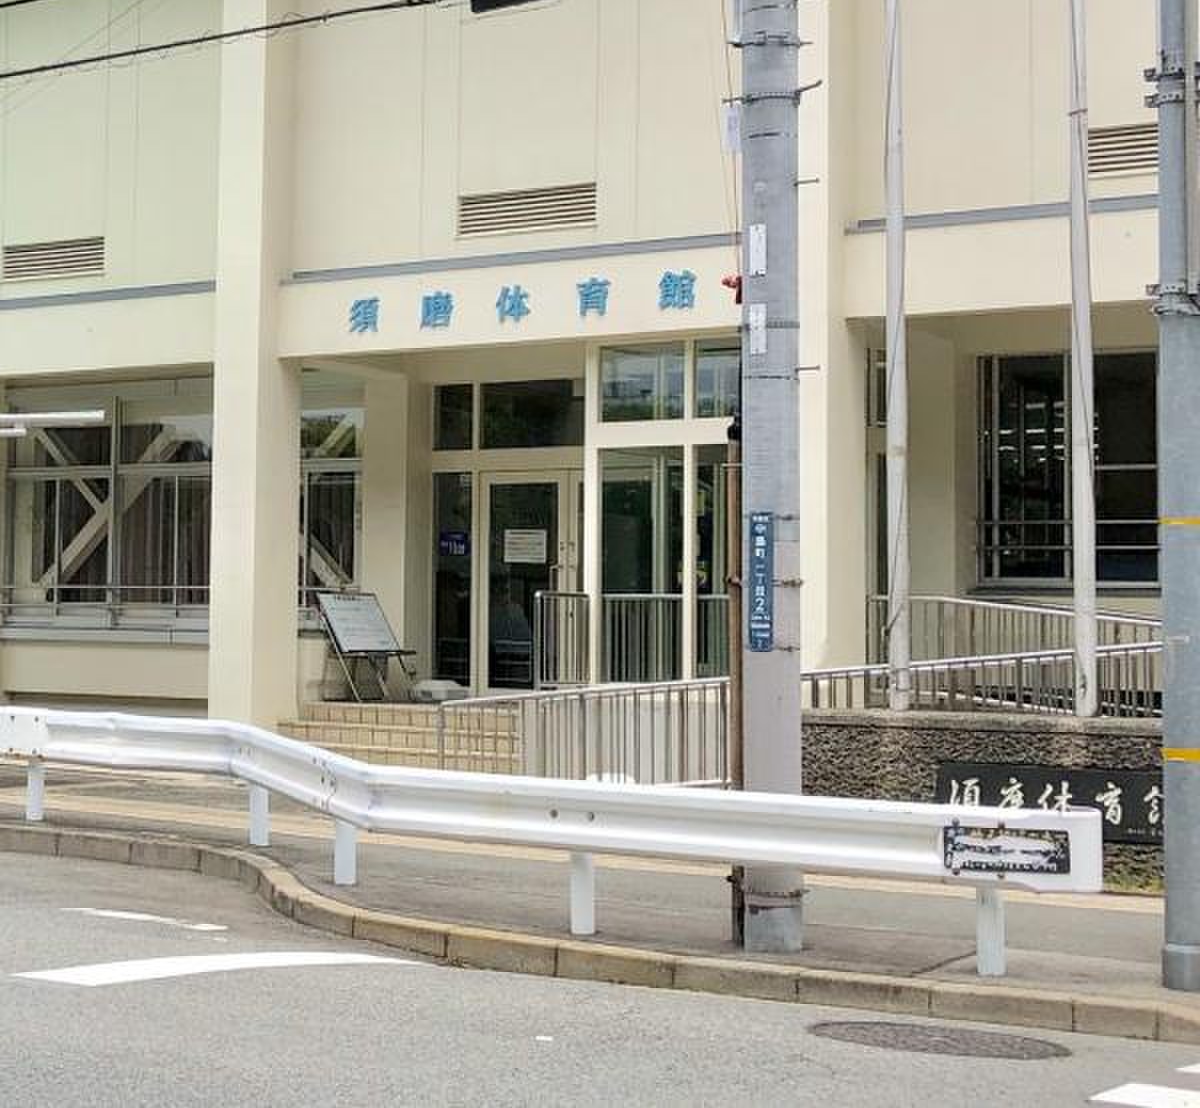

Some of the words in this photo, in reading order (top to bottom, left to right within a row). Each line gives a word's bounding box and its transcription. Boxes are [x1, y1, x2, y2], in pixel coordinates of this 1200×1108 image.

[349, 270, 697, 333] 須磨体育館
